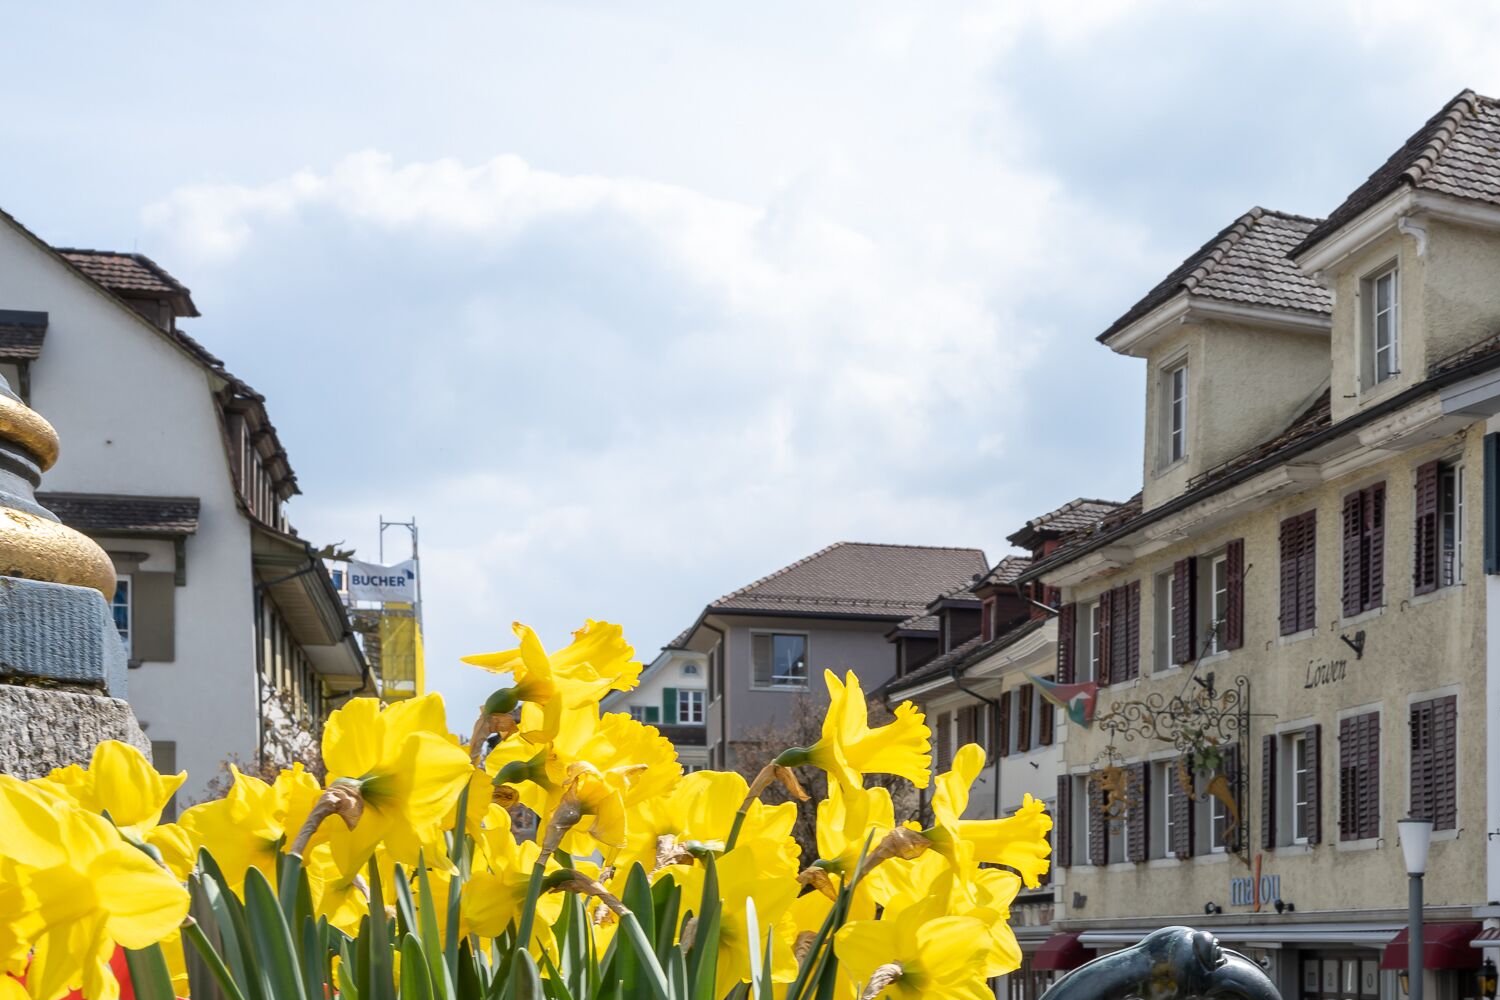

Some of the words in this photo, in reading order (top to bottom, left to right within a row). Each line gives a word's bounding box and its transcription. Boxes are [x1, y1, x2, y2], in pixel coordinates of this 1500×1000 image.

[352, 574, 406, 587] BUCHER
[1304, 658, 1347, 689] Löwen
[1231, 853, 1281, 912] malou
